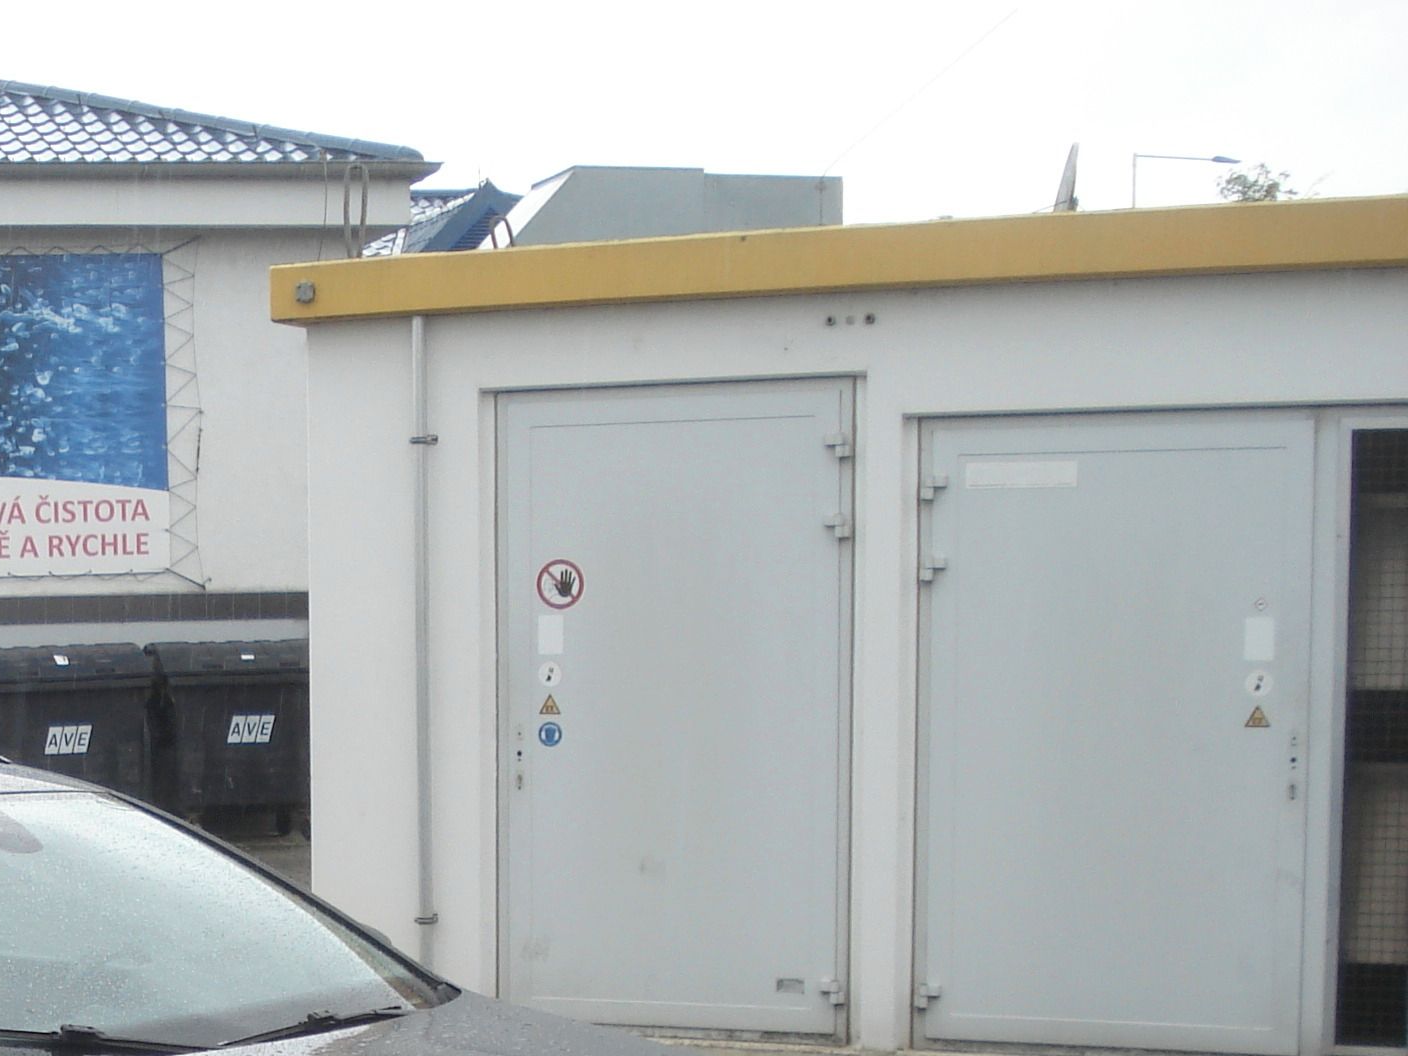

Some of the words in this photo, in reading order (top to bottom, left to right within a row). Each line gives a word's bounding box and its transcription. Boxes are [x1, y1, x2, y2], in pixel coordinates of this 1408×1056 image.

[35, 495, 151, 524] ČISTOTA
[20, 535, 39, 558] A
[48, 533, 150, 558] RYCHLE
[230, 720, 272, 737] AVE
[46, 731, 89, 748] AVE
